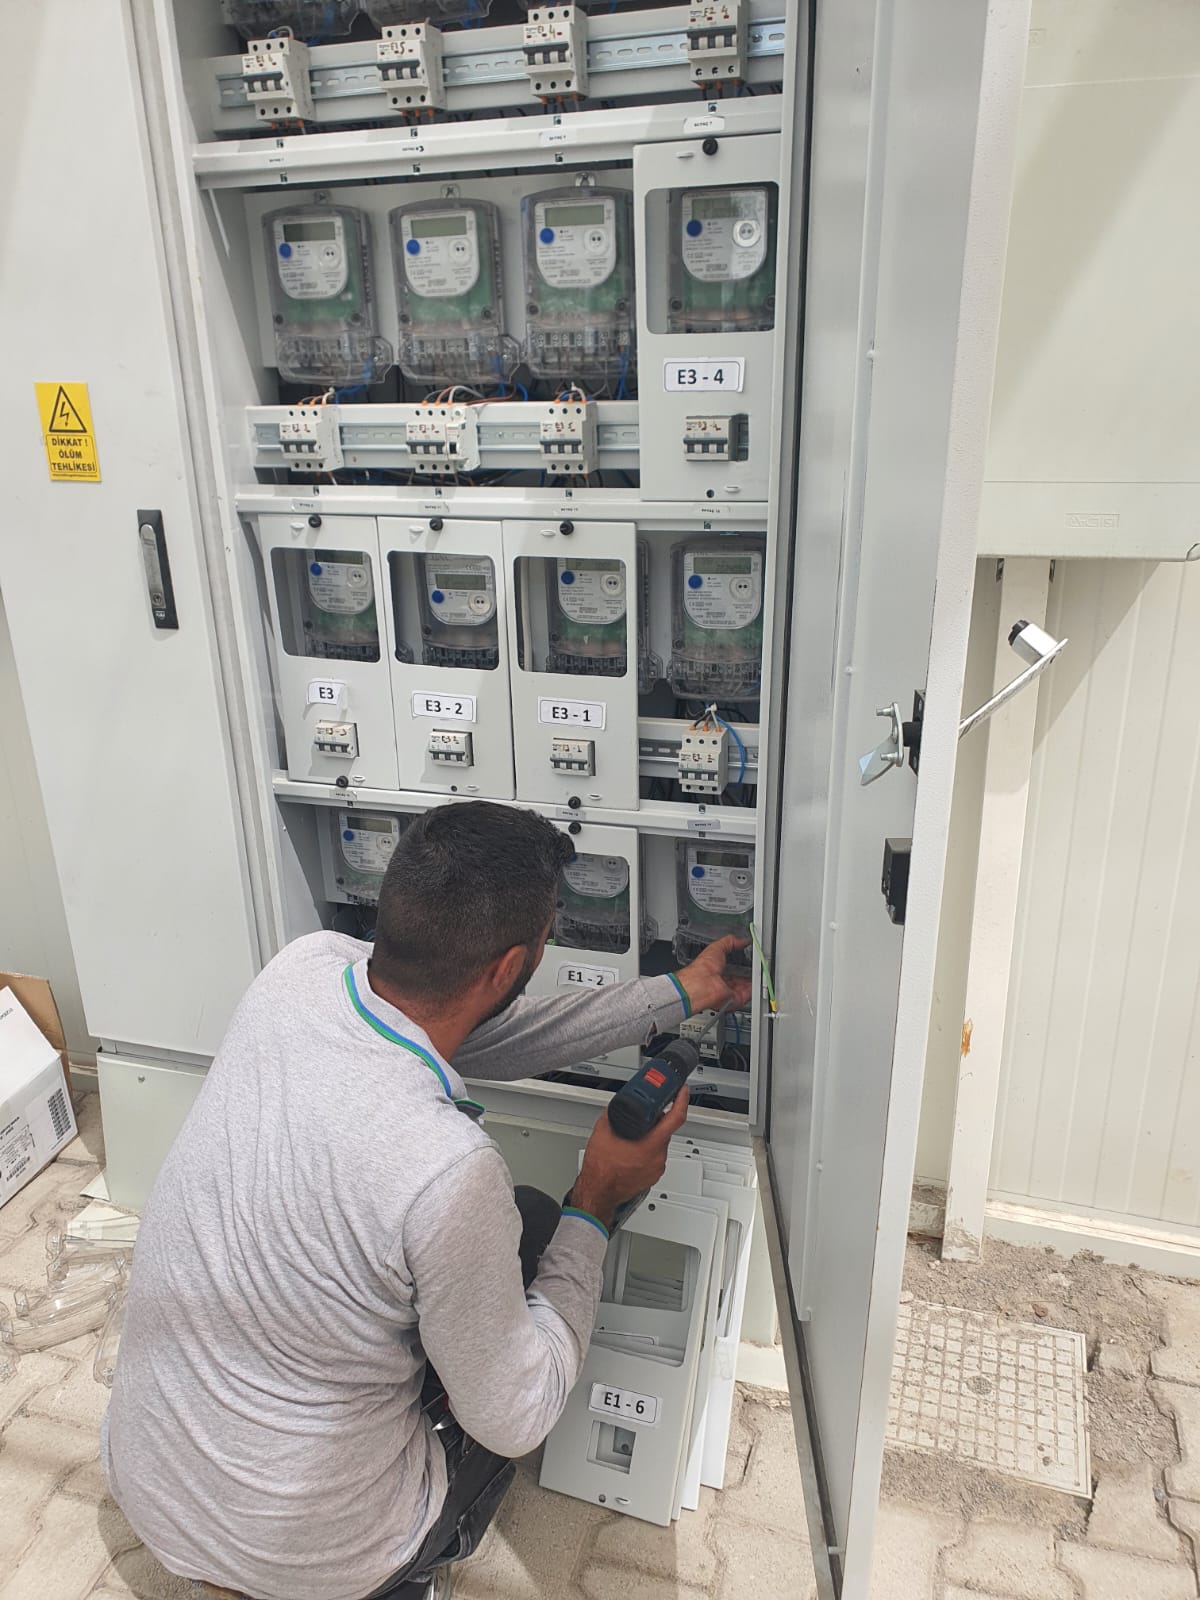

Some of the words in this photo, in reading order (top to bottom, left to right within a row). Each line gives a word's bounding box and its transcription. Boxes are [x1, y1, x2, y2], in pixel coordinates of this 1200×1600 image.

[677, 368, 697, 385] E3
[713, 368, 724, 385] 4
[51, 434, 83, 447] DİKKAT
[58, 448, 83, 459] ÖLÜM
[52, 462, 95, 471] TEHLİKESİ
[318, 686, 335, 700] E3
[425, 699, 442, 713] E3
[454, 702, 464, 715] 2
[552, 706, 569, 720] E3
[582, 709, 592, 722] 1
[567, 970, 584, 983] E1
[596, 974, 605, 986] 2
[604, 1392, 620, 1408] E1
[636, 1400, 645, 1414] 6
